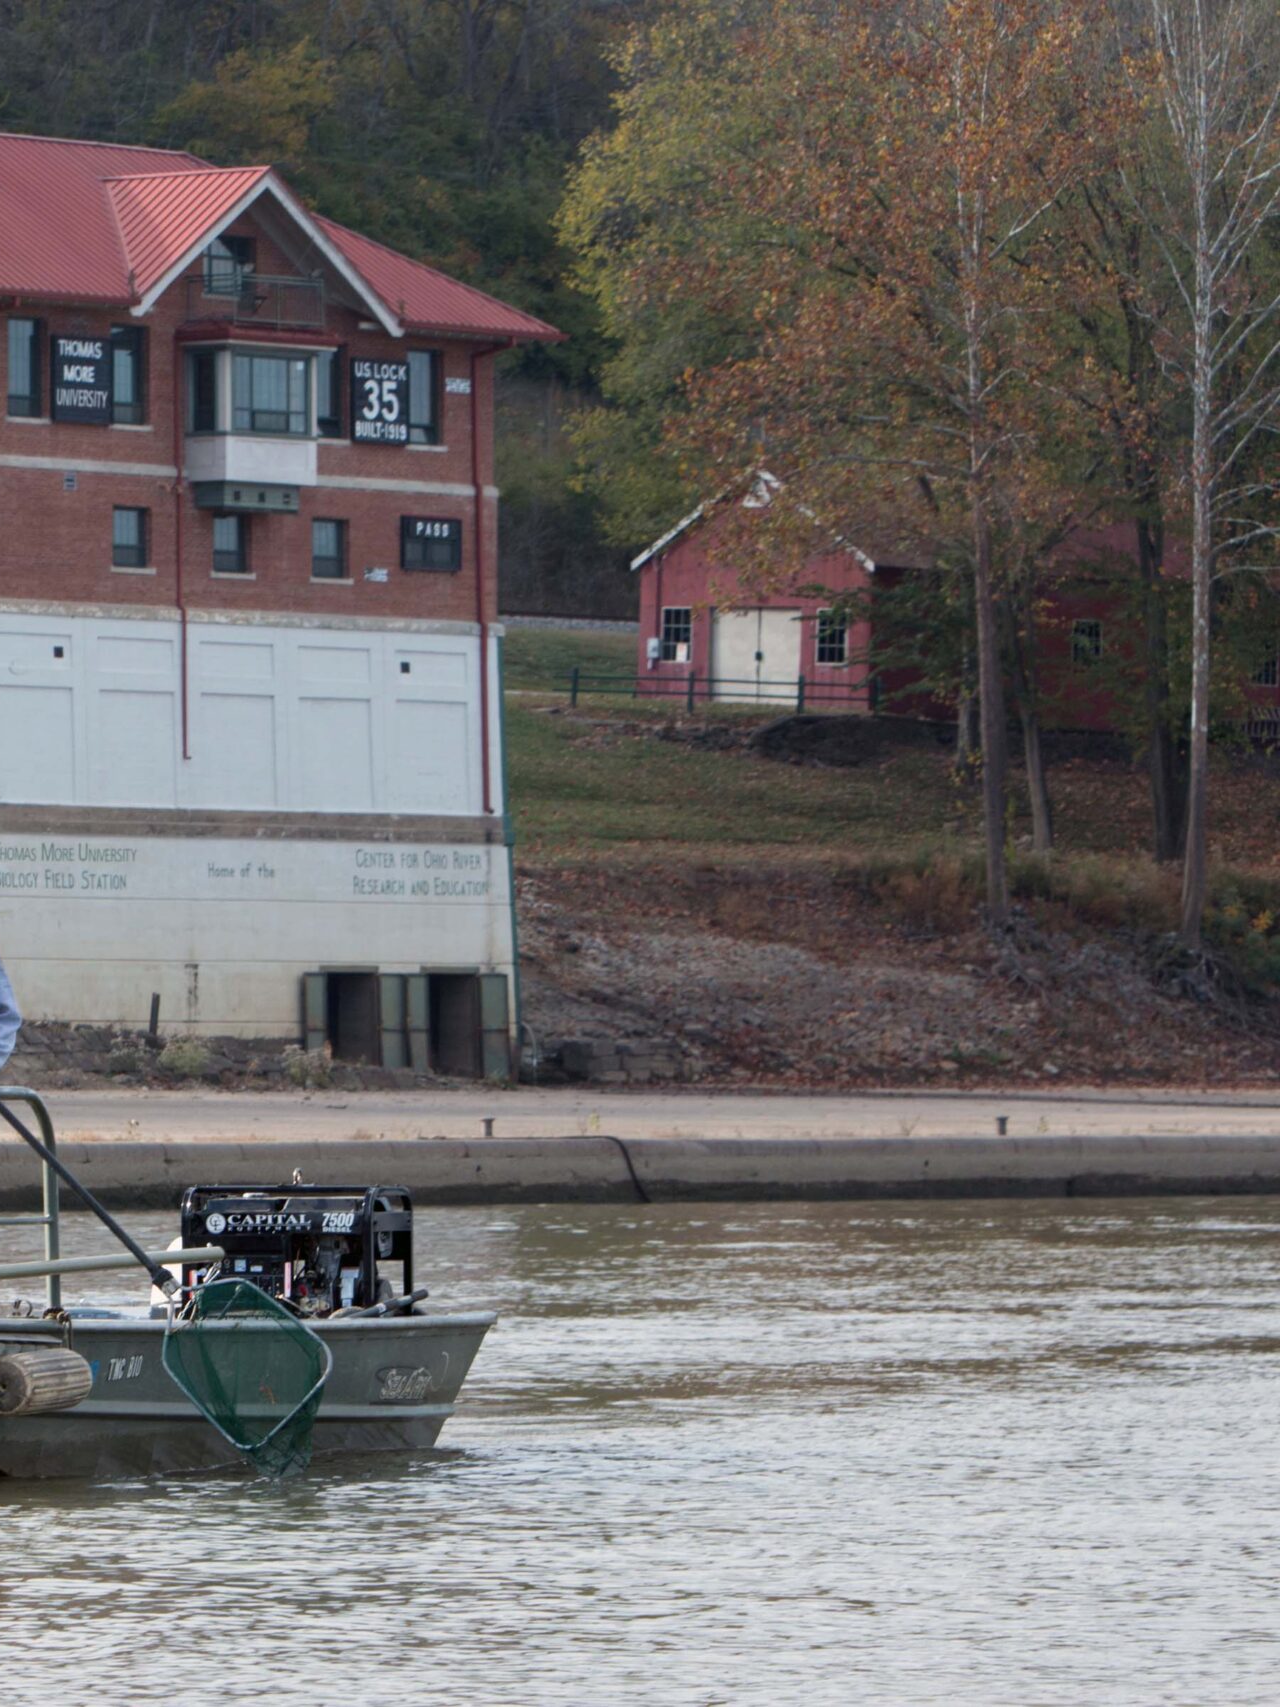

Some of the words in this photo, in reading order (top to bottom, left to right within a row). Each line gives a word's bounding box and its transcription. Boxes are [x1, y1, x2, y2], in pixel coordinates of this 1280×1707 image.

[58, 339, 102, 359] THOMAS
[63, 364, 95, 383] MORE
[374, 363, 407, 381] LOCK
[56, 388, 108, 408] UNIVERSITY
[362, 380, 399, 422] 35
[416, 521, 449, 538] PASS
[227, 1213, 312, 1225] CAPITAL
[322, 1212, 355, 1227] 7500
